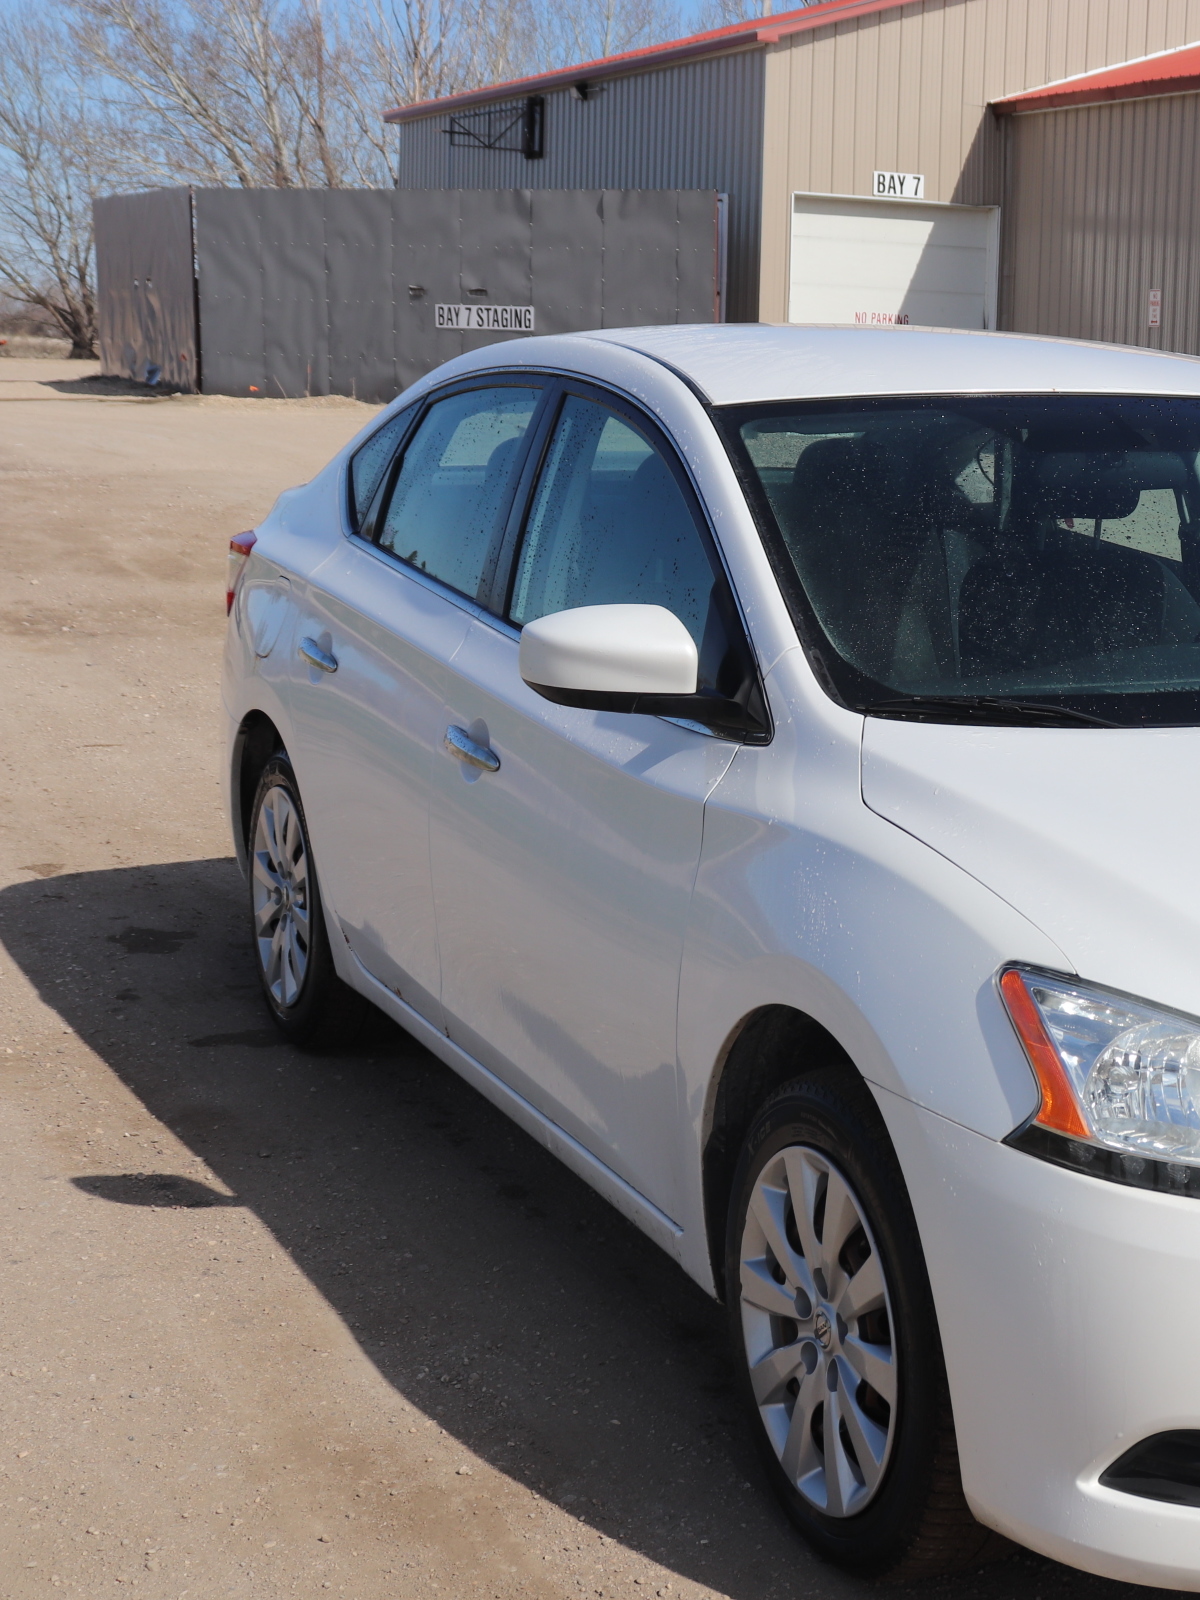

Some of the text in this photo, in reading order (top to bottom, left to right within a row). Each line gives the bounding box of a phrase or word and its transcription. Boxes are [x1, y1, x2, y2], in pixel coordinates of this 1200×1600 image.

[877, 173, 921, 196] BAY 7
[438, 306, 531, 329] BAY 7 STAGING
[855, 311, 909, 325] NO PARKING
